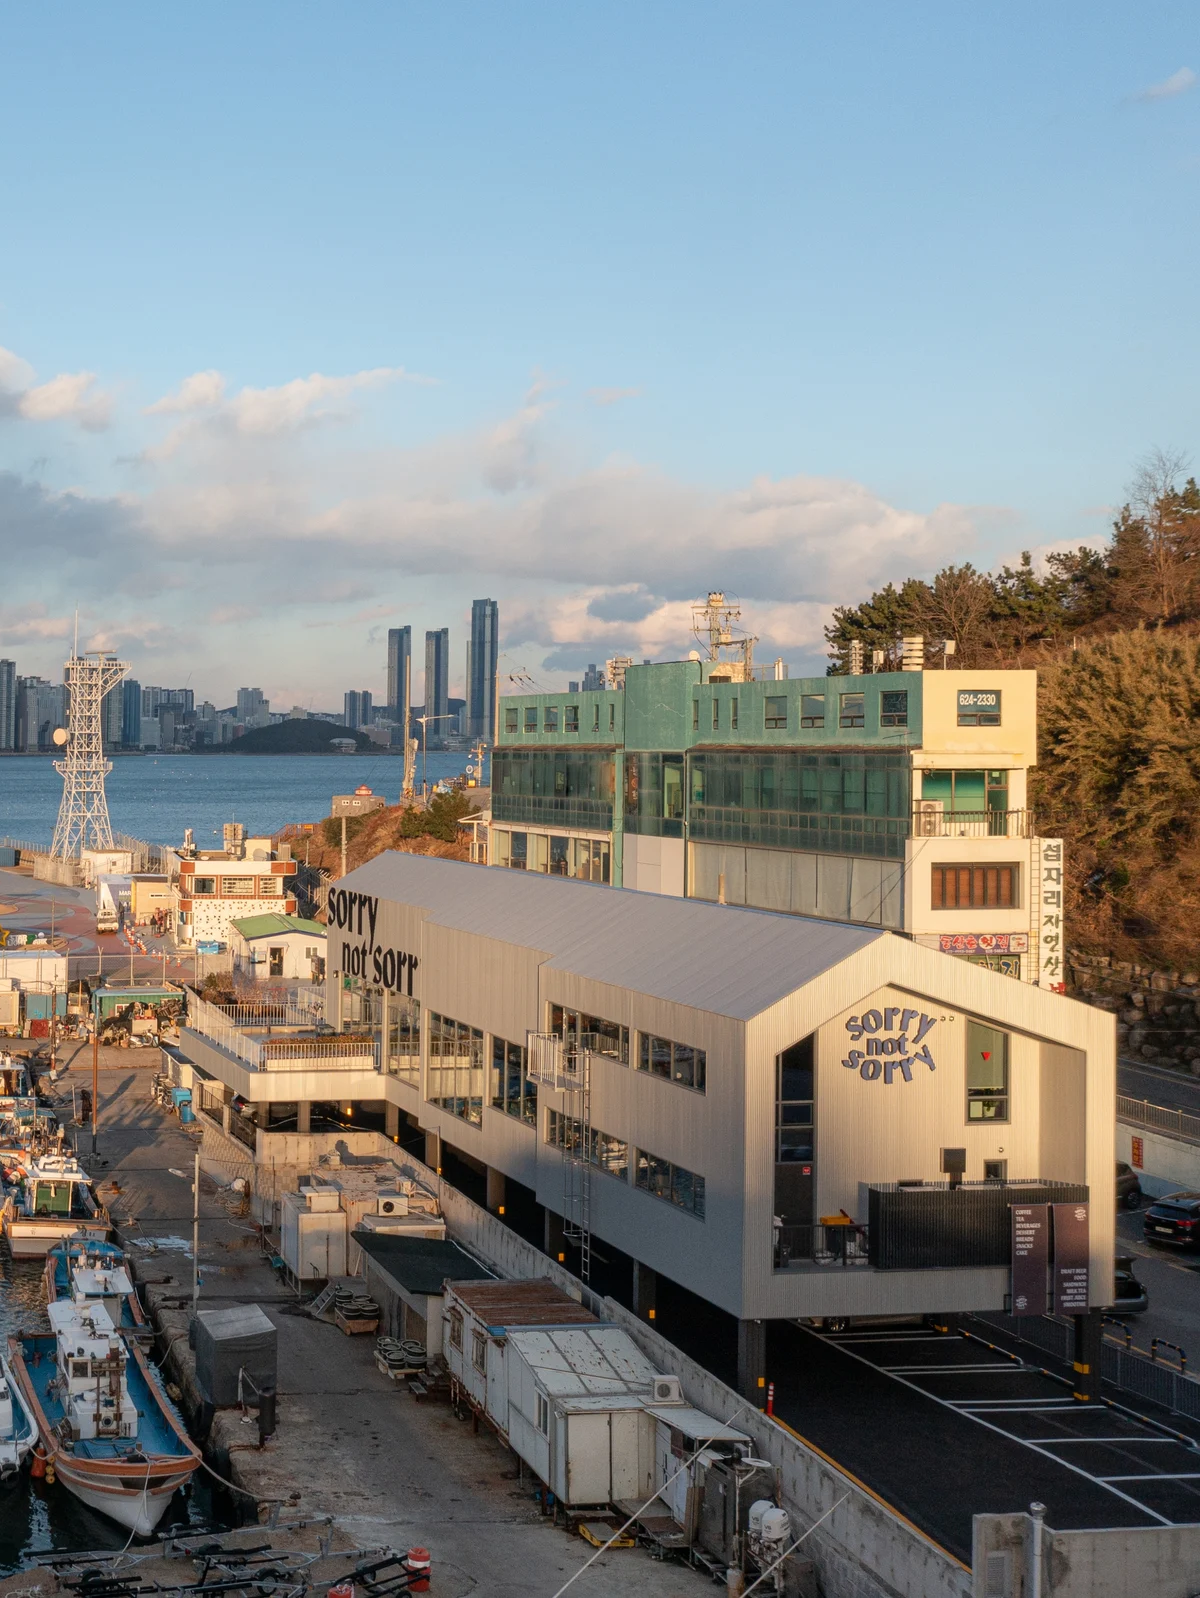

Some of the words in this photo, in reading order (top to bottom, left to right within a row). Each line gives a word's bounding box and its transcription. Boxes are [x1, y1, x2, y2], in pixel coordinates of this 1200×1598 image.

[959, 693, 996, 706] 624-2330
[1043, 844, 1061, 909] 섭자리
[327, 887, 379, 956] sorry
[1043, 913, 1060, 977] 자연산
[342, 939, 368, 980] not
[372, 945, 422, 997] sorr
[845, 1007, 937, 1045] sorry
[866, 1032, 909, 1056] not
[841, 1044, 936, 1084] sorry
